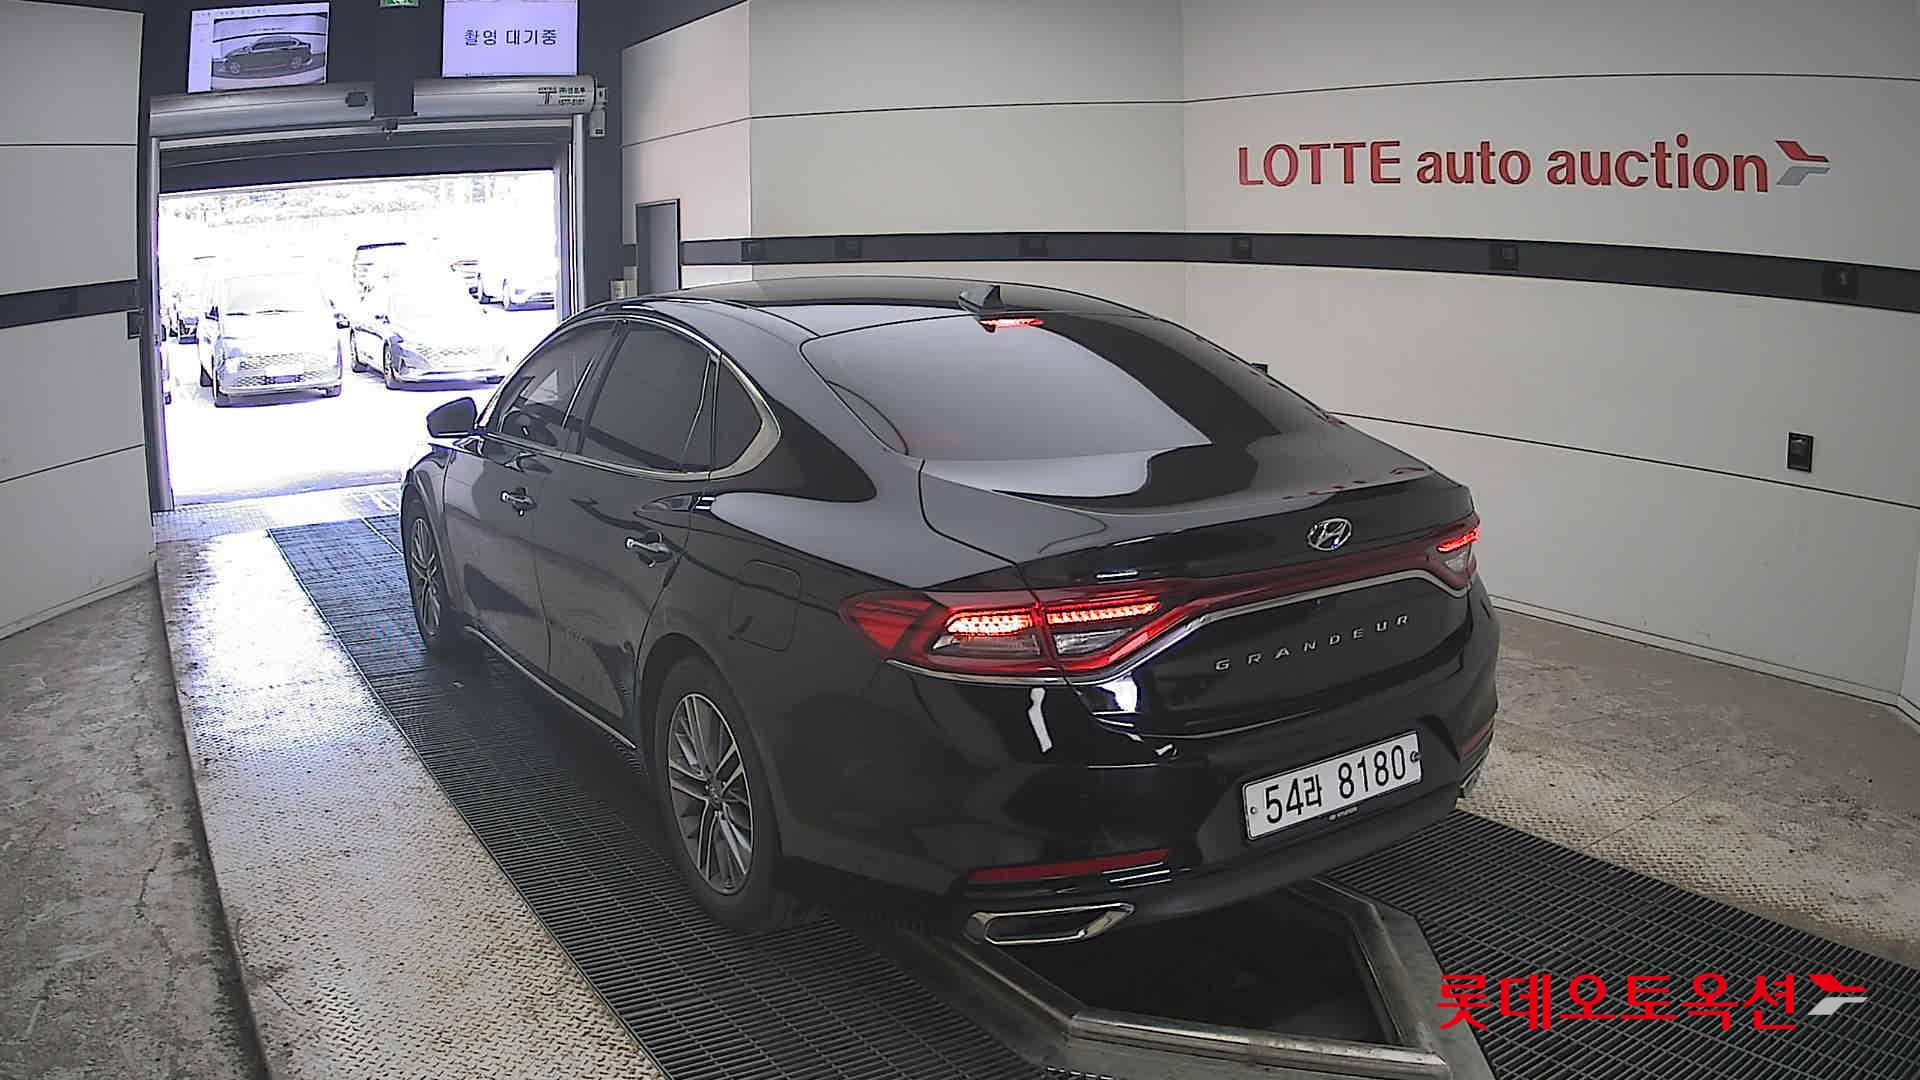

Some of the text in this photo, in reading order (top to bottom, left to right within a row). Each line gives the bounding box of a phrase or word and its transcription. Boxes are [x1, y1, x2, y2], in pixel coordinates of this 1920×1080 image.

[464, 29, 558, 47] 촬영 대기중
[1238, 133, 1769, 194] LOTTE auto auction
[1215, 615, 1408, 671] GRANDEUR
[1264, 745, 1407, 824] 54라 8180
